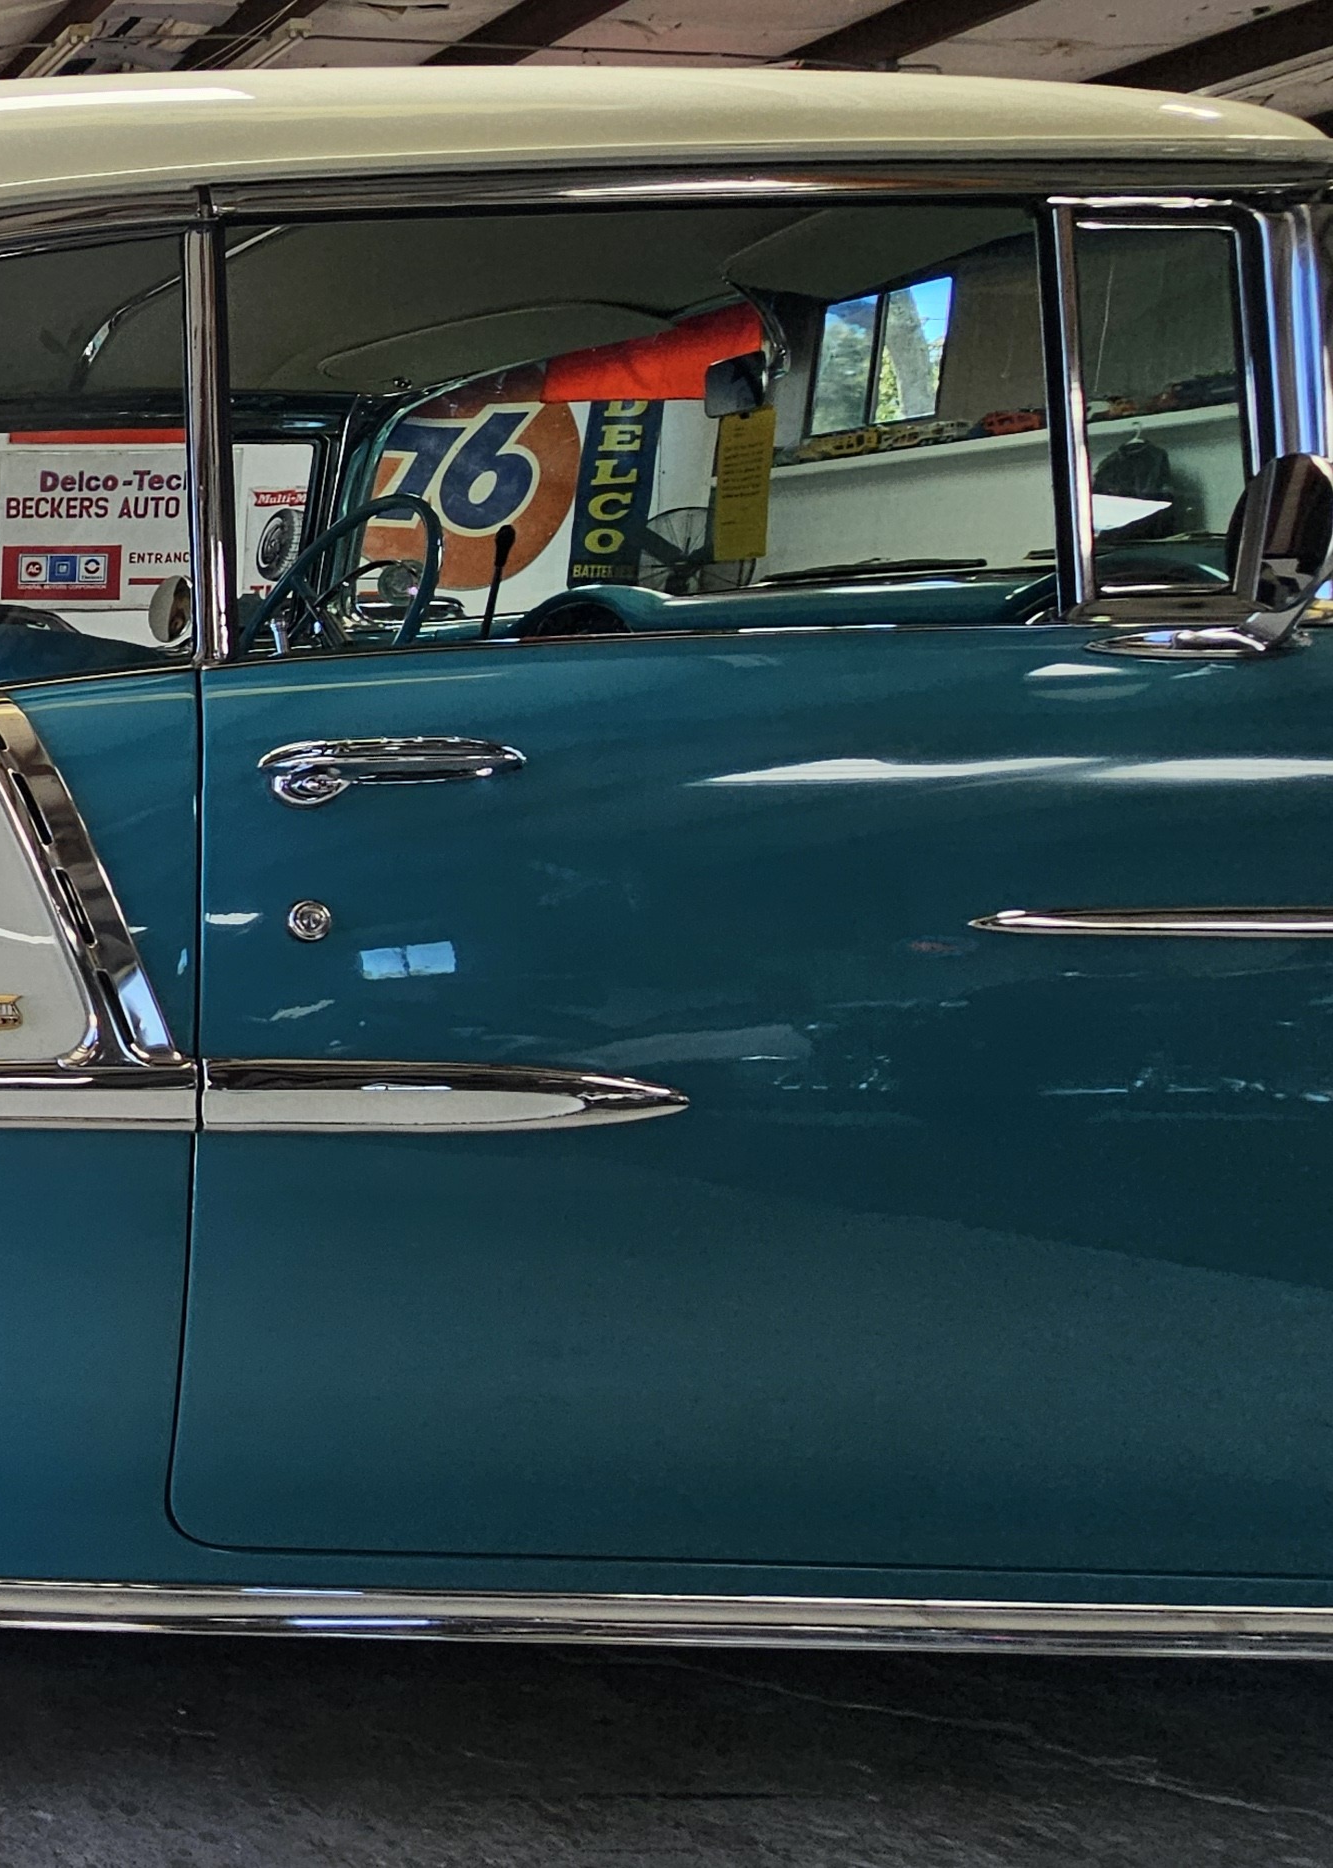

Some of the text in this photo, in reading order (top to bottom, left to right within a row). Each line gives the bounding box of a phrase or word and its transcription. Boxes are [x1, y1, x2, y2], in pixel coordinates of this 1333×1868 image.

[40, 470, 187, 493] Delco-Tec
[5, 496, 181, 519] BECKERS AUTO
[129, 552, 190, 564] ENTRANC
